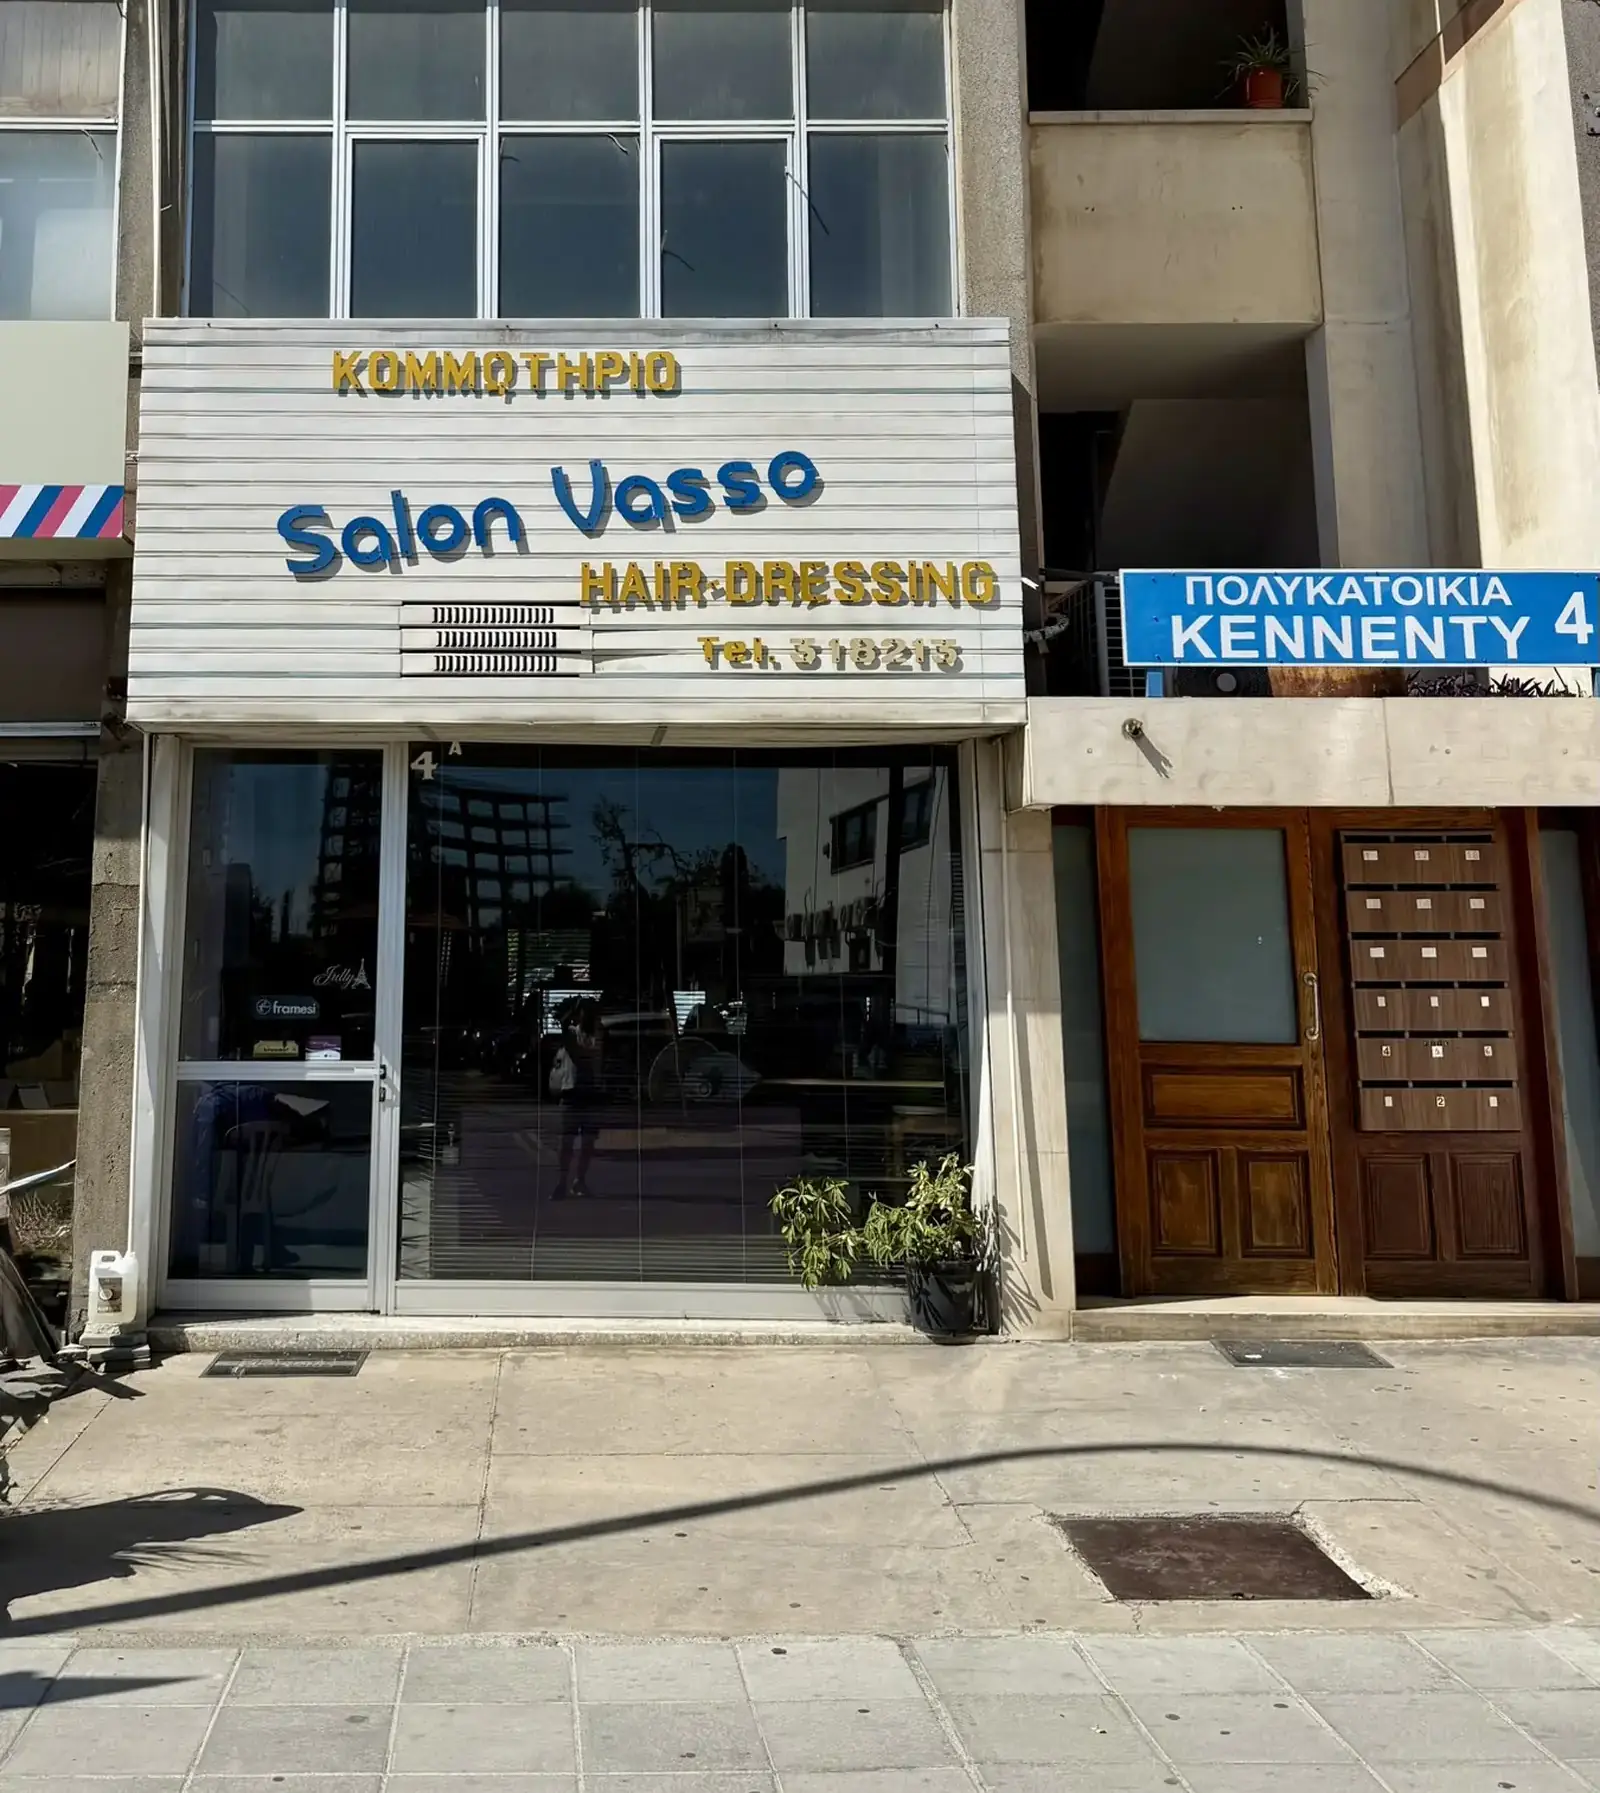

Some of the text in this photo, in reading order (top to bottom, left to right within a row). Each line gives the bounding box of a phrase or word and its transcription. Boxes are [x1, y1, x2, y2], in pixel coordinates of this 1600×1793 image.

[276, 450, 819, 574] Salon Vasso
[1185, 575, 1512, 607] ΠΟΛΥΚΑΤΟΙΚΙΑ
[1554, 591, 1594, 645] 4
[697, 636, 776, 664] Tel.
[1171, 614, 1531, 660] ΚΕΝΝΕΝΤΥ
[410, 750, 439, 780] 4
[272, 1000, 317, 1015] framesi
